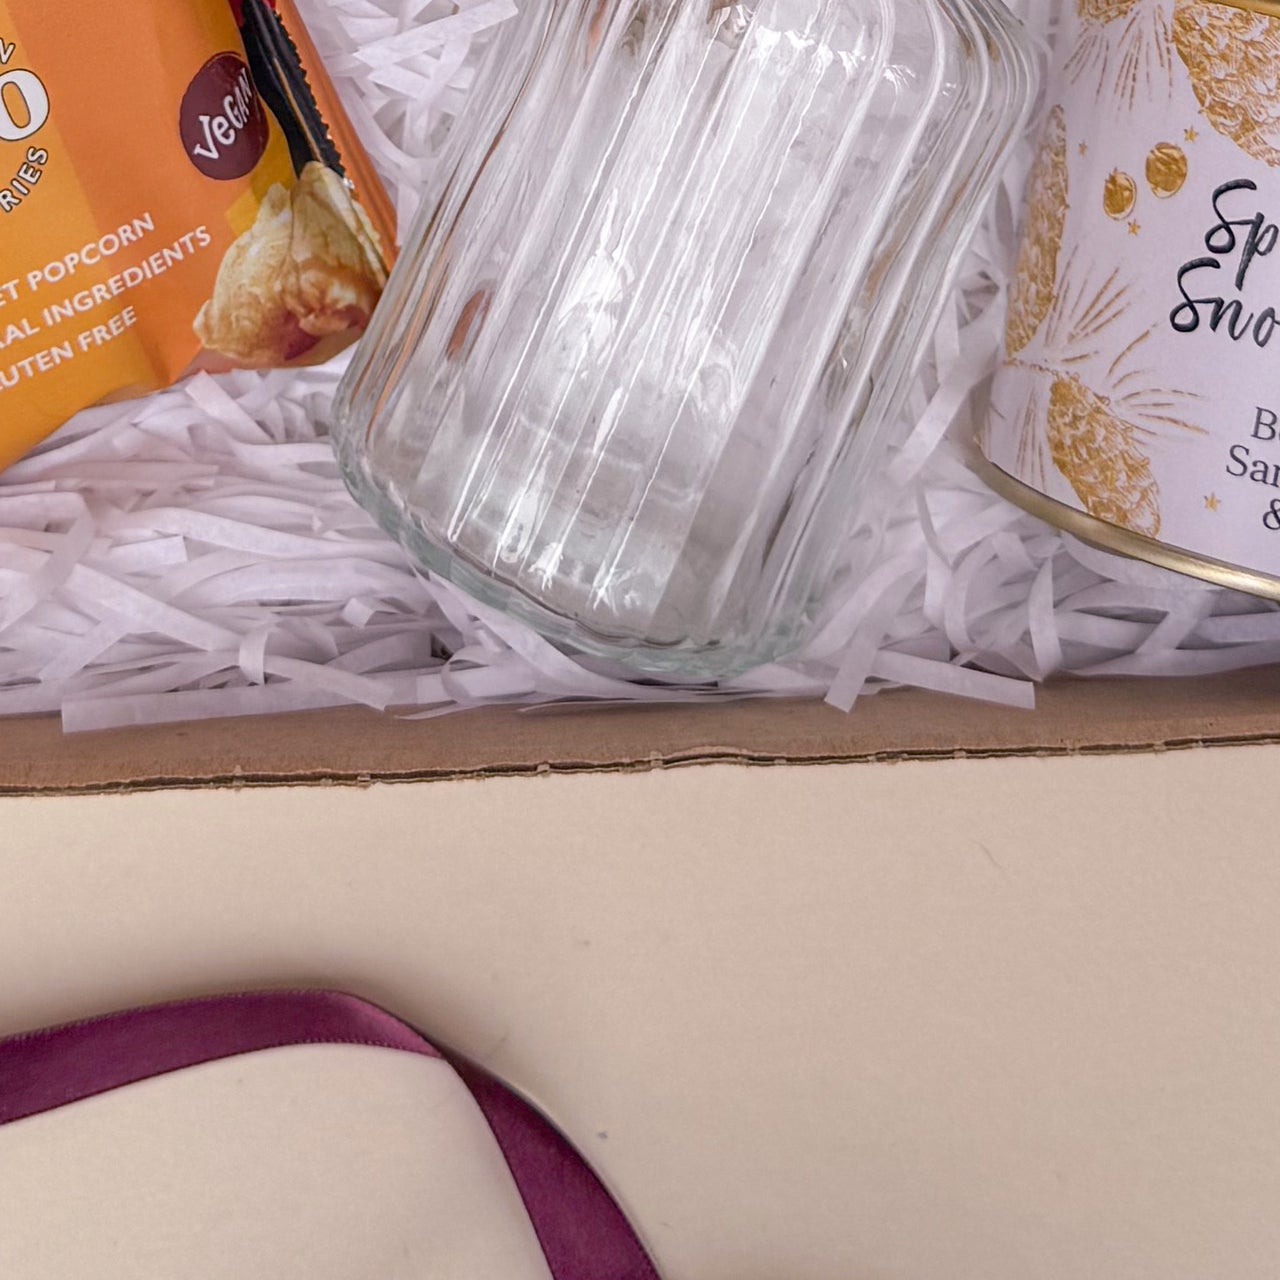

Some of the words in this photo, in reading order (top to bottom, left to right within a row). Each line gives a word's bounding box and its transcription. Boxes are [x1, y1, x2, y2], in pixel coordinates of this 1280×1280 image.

[28, 212, 156, 292] POPCORN
[42, 225, 213, 328] INGREDIENTS
[77, 305, 138, 354] FREE
